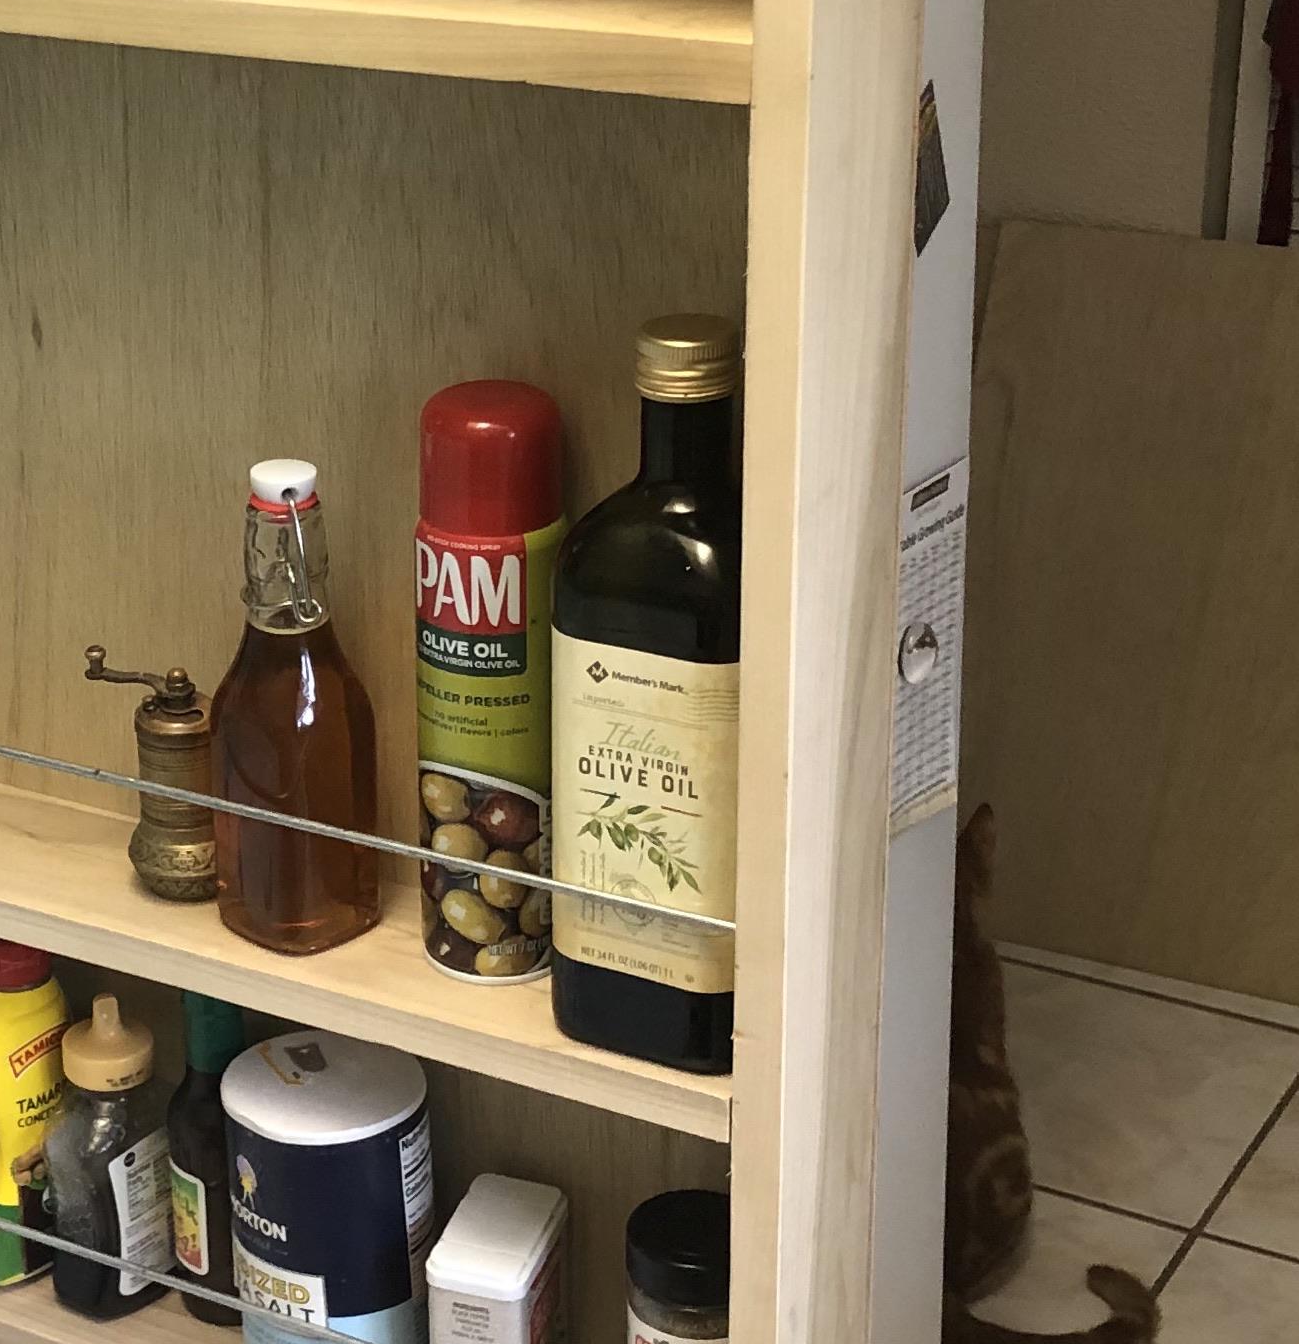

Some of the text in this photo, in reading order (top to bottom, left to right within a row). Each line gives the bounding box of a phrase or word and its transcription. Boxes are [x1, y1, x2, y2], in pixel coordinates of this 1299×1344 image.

[415, 537, 521, 627] PAM
[422, 630, 509, 658] OLIVE OIL
[444, 655, 473, 668] VIRGIN
[474, 660, 504, 670] OLIVE
[504, 659, 521, 669] OIL
[418, 679, 530, 708] PELLER PRESSED
[611, 670, 658, 689] Member's
[447, 714, 488, 727] artificial
[598, 720, 682, 761] Italian
[588, 744, 689, 776] EXTRA VIRGIN
[578, 756, 699, 800] OLIVE OIL
